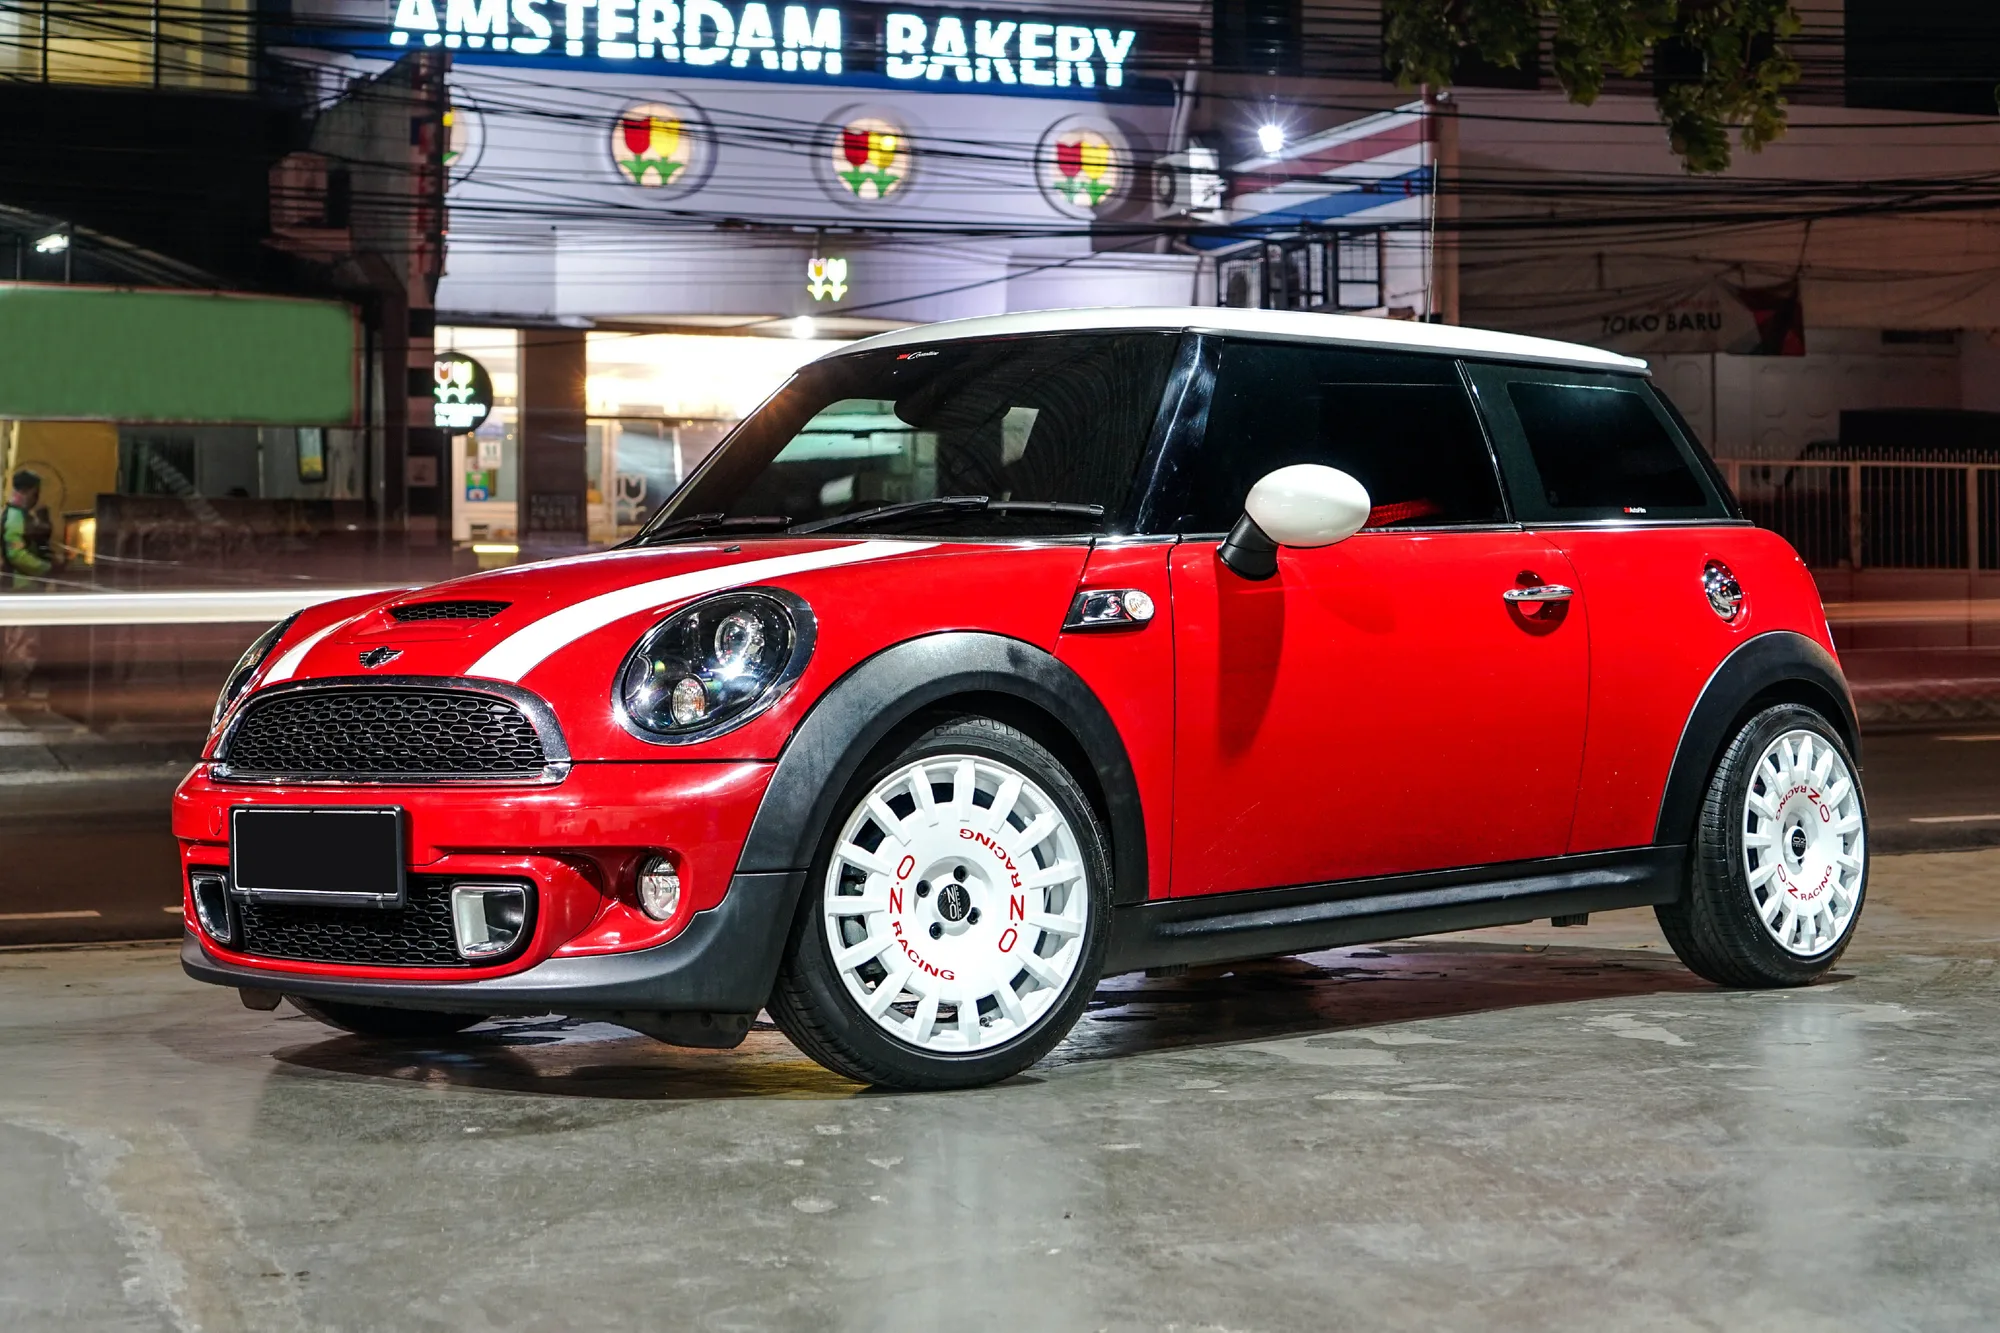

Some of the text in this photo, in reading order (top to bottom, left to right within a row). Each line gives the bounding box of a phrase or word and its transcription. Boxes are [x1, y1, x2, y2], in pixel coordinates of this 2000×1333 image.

[389, 0, 1136, 88] AMSTERDAM BAKERY
[1601, 312, 1722, 334] TOKO BARU
[1775, 785, 1807, 821] RACING
[959, 828, 1022, 888] RACING
[1800, 864, 1833, 901] RACING
[892, 921, 955, 981] RACING
